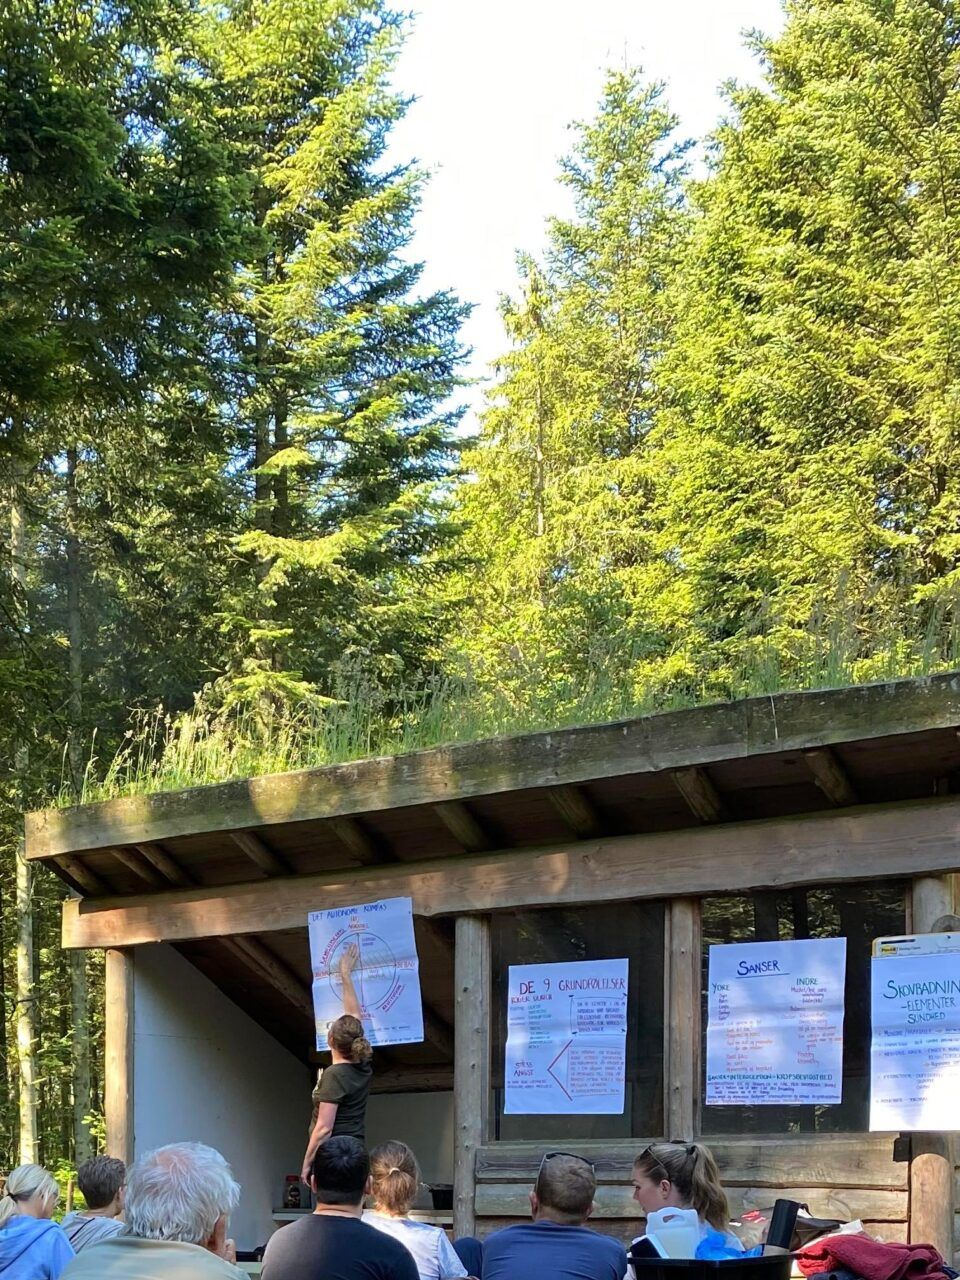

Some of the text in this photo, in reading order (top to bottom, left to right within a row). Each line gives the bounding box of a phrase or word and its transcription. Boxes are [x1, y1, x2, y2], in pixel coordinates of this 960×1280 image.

[737, 960, 780, 975] SANSER
[520, 981, 535, 994] DE
[543, 979, 550, 992] 9
